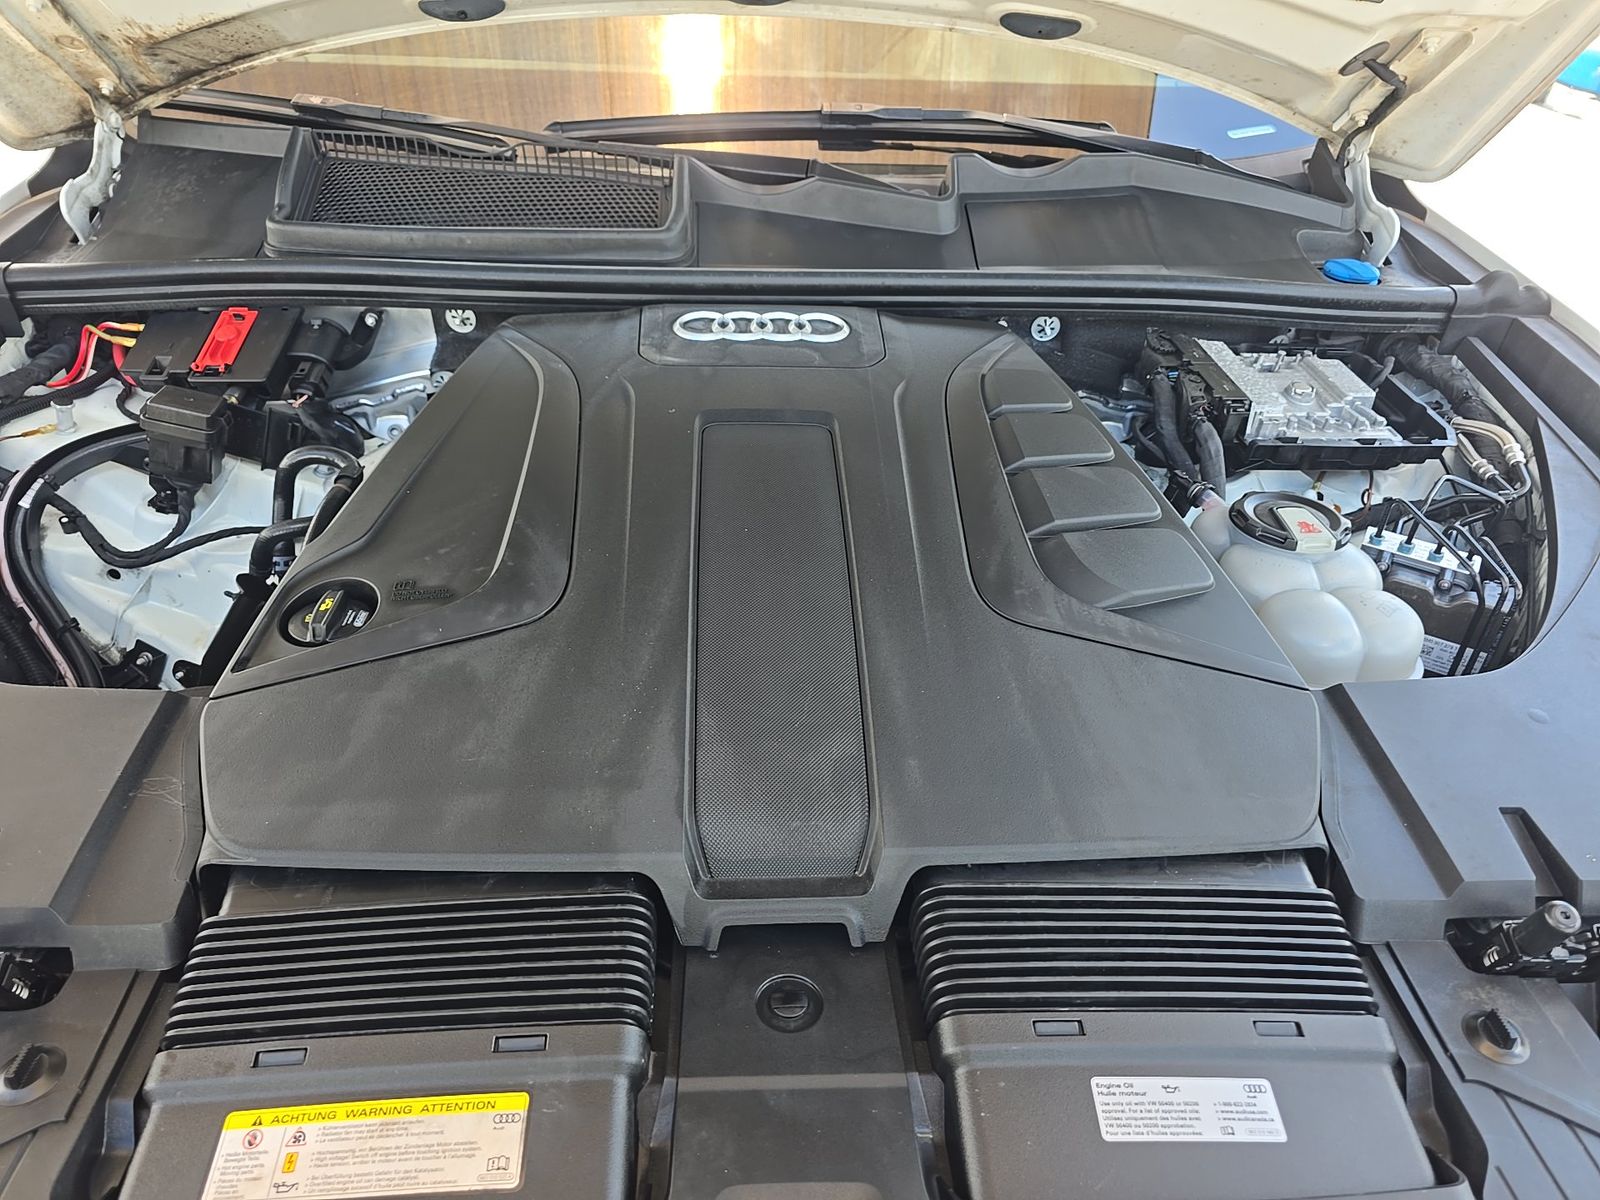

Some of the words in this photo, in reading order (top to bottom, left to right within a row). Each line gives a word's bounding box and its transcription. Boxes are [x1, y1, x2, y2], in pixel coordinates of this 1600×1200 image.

[270, 1110, 337, 1125] ACHTUNG
[345, 1105, 412, 1119] WARNING
[420, 1100, 496, 1114] ATTENTION
